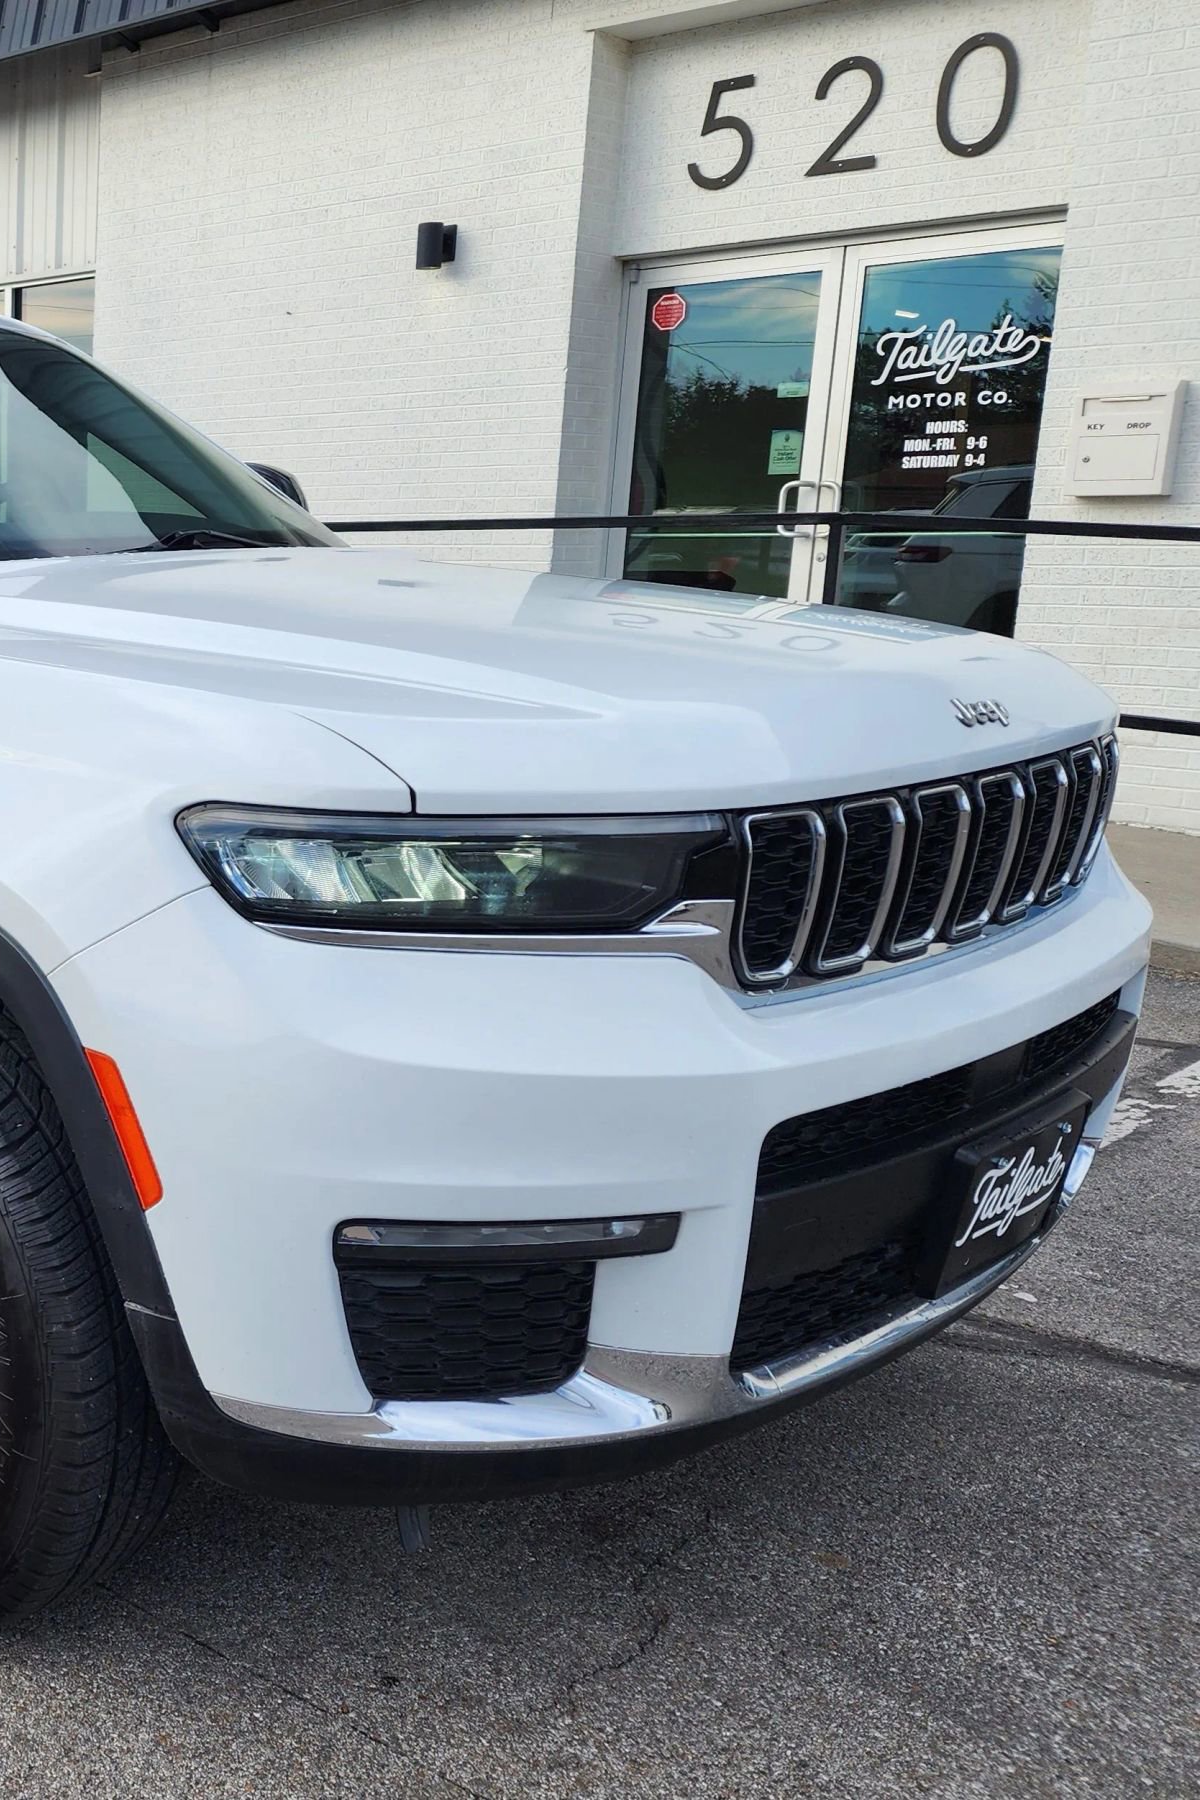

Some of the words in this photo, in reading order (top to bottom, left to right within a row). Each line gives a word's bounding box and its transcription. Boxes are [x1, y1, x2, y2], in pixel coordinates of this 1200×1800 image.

[687, 32, 1019, 190] 520
[870, 314, 1041, 386] Tailgate
[887, 392, 967, 409] MOTOR
[977, 390, 1013, 405] CO.
[925, 420, 969, 434] HOURS:
[903, 437, 957, 452] MON.-FRI.
[966, 436, 988, 449] 9-6
[901, 454, 960, 469] SATURDAY
[964, 454, 986, 466] 9-4
[950, 698, 1010, 728] Jeep
[955, 1136, 1066, 1248] Tailgate
